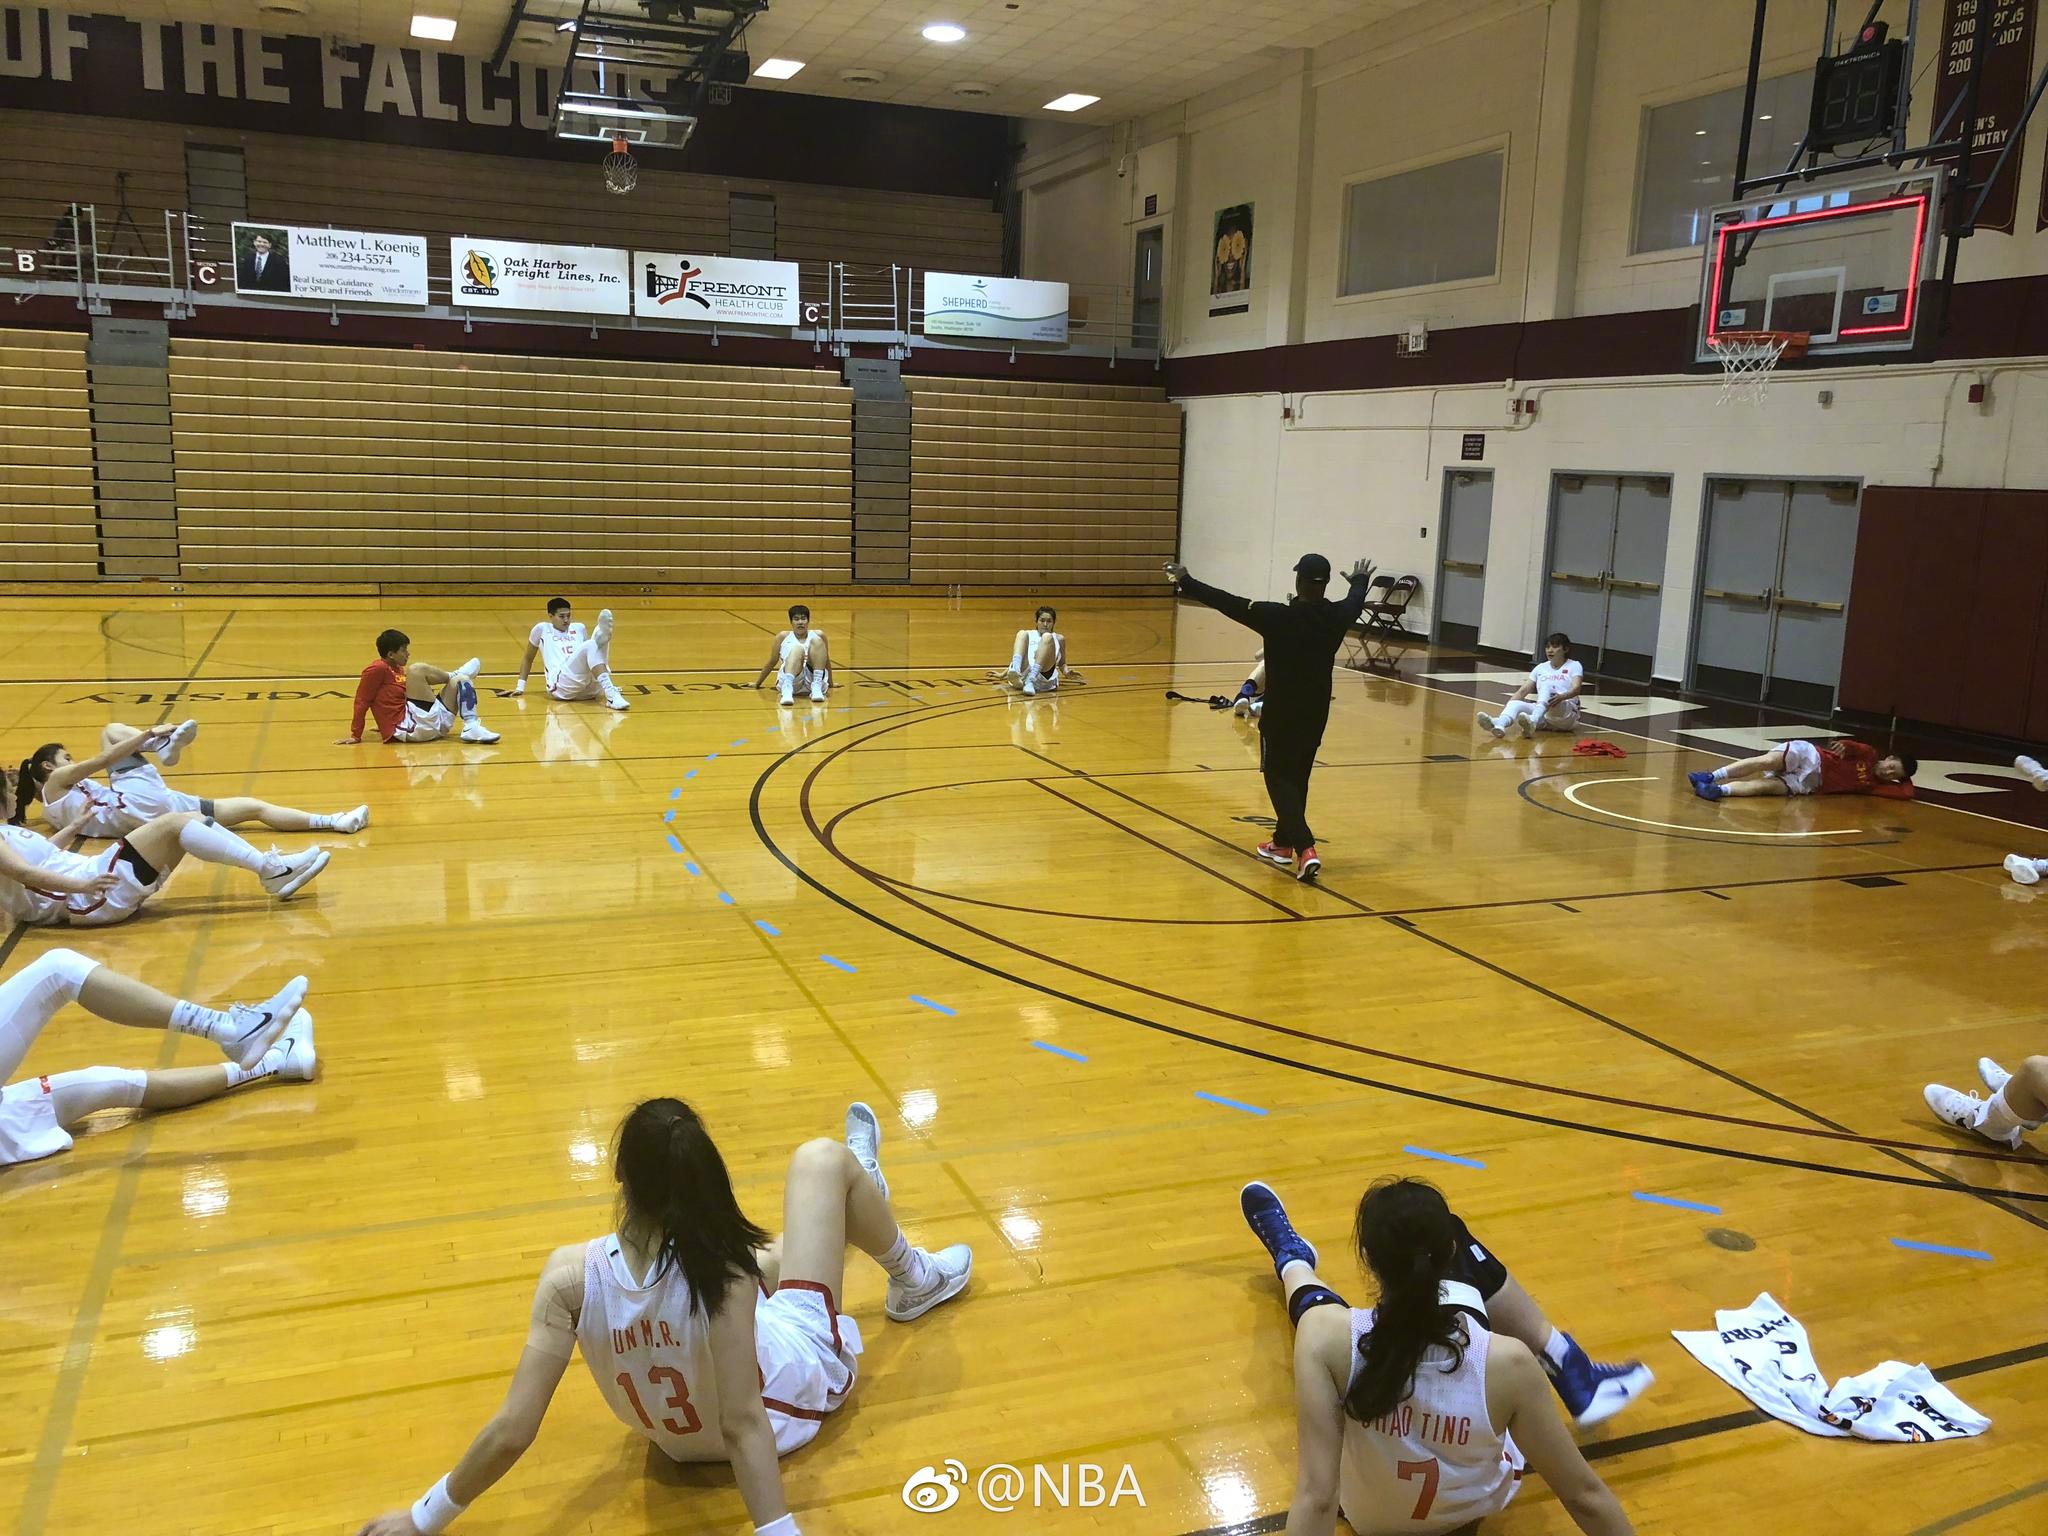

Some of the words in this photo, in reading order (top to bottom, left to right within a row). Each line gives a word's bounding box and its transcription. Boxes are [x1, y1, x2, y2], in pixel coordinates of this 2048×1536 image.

[125, 12, 291, 104] THE
[296, 234, 357, 251] Matthew
[360, 238, 372, 251] L.
[374, 239, 420, 258] Koenig
[17, 254, 35, 272] B
[340, 252, 393, 266] 234-5574
[503, 257, 529, 268] Oak
[533, 259, 577, 271] Harbor
[199, 266, 216, 284] C
[292, 275, 310, 285] Real
[311, 276, 335, 286] Estate
[336, 278, 374, 289] Guidance
[504, 268, 550, 280] Freight
[558, 271, 595, 283] Lines,
[598, 273, 621, 284] Inc.
[294, 284, 307, 293] For
[309, 285, 326, 294] SPU
[327, 286, 343, 296] and
[344, 287, 373, 298] Friends
[688, 280, 787, 298] FREMONT
[715, 298, 754, 309] HEALTH
[757, 301, 784, 311] CLUB
[942, 296, 988, 309] SHEPHERD
[805, 306, 818, 322] C
[616, 1365, 703, 1435] 13
[1421, 1412, 1471, 1446] TING
[1397, 1457, 1440, 1521] 7
